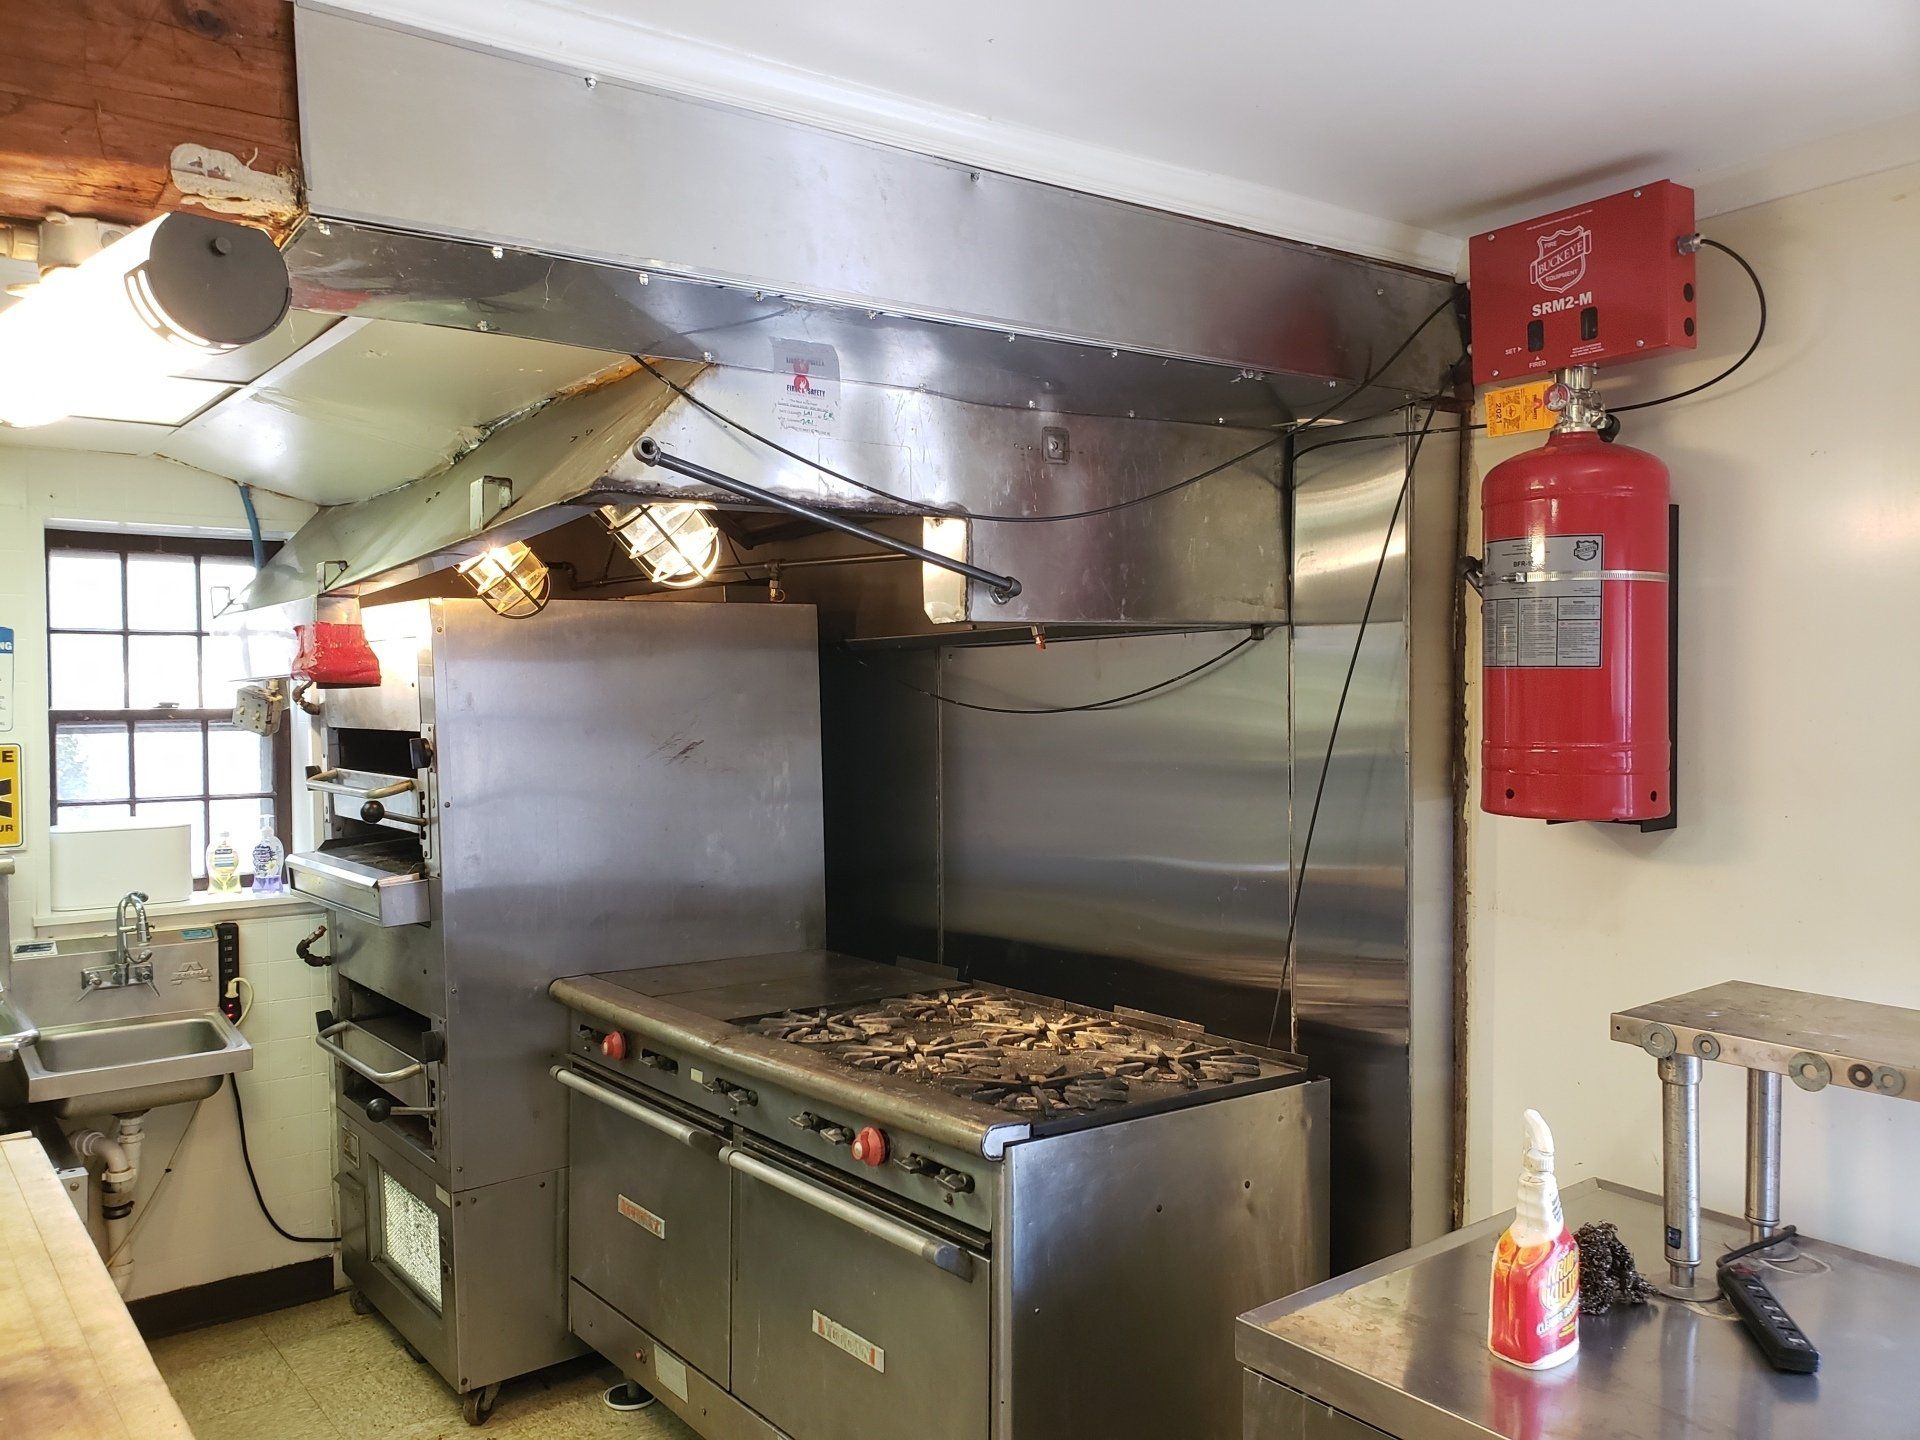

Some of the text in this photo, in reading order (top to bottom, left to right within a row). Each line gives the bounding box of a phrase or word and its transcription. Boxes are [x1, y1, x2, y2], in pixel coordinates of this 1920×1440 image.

[1544, 241, 1557, 249] FIRE
[1538, 241, 1583, 275] BUCKEYE
[1546, 269, 1579, 282] EQUIPMENT
[1532, 291, 1592, 317] SRM2-M
[1505, 348, 1517, 356] SET
[1529, 360, 1547, 368] FIRED
[1495, 402, 1503, 424] 2021
